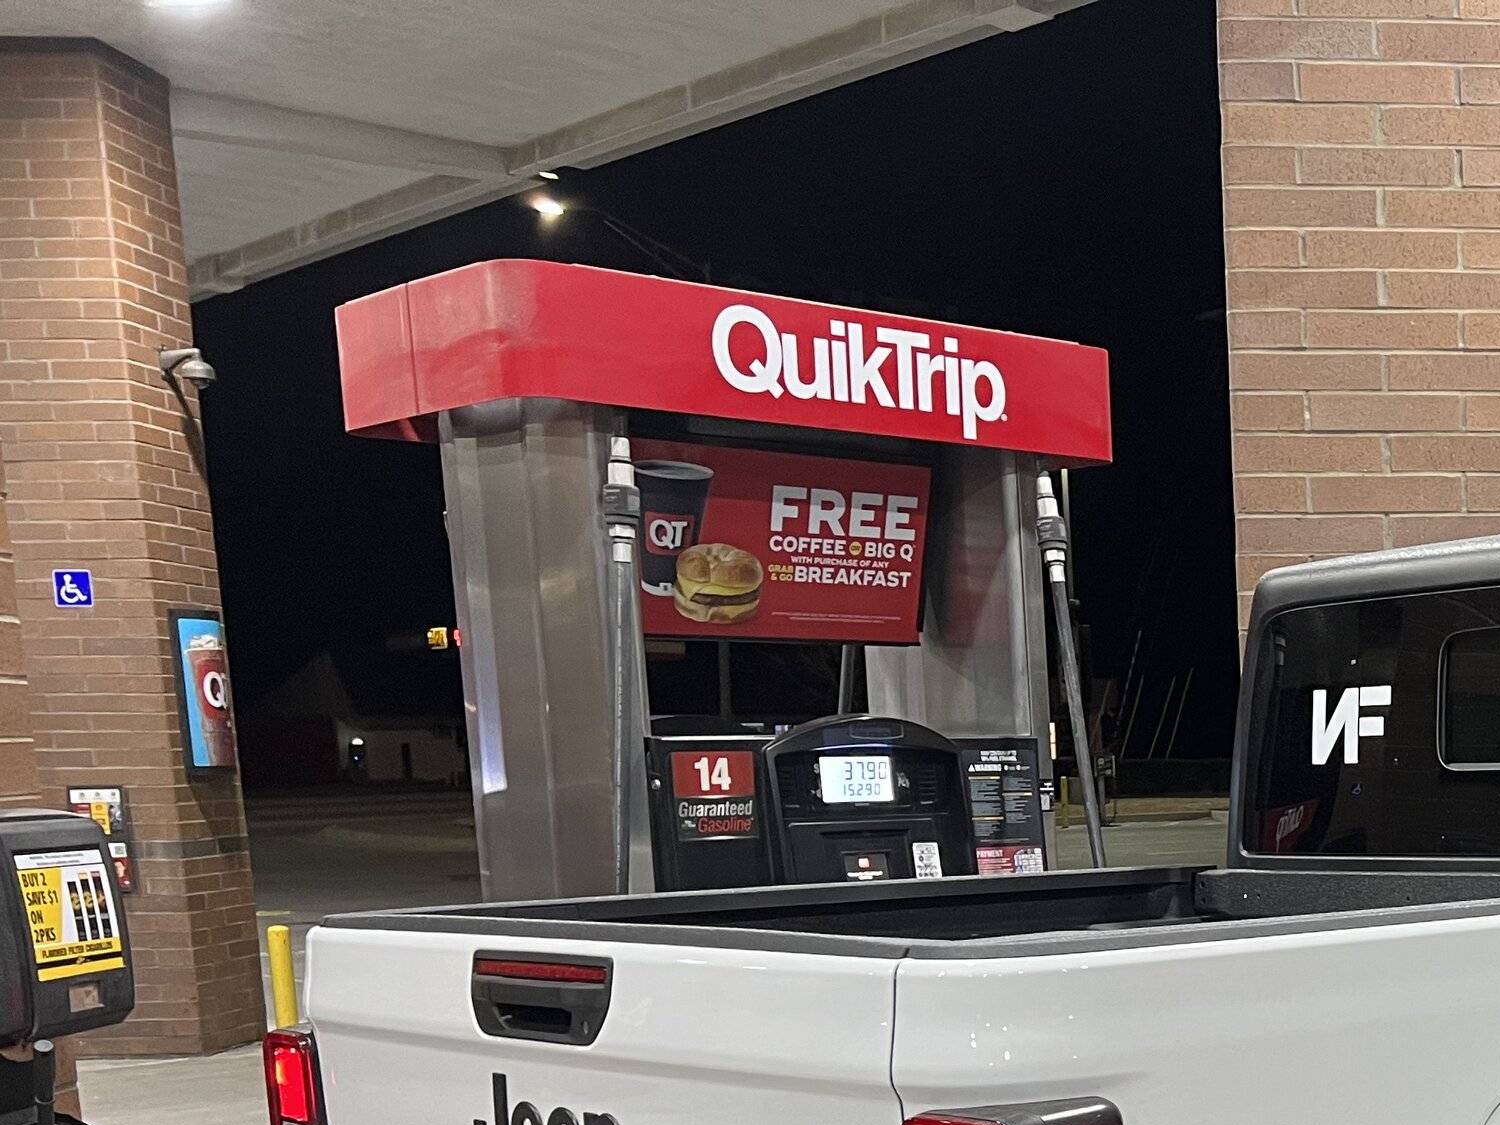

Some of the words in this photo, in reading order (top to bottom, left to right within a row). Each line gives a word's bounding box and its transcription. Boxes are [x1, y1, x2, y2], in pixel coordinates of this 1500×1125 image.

[712, 304, 1006, 440] QuikTrip
[770, 485, 918, 541] FREE
[649, 518, 688, 549] QT
[769, 535, 847, 556] COFFEE
[864, 541, 896, 559] BIG
[900, 543, 914, 562] Q
[768, 564, 794, 574] GRAB
[791, 555, 813, 565] WITH
[814, 556, 858, 567] PURCHASE
[859, 560, 871, 568] OF
[871, 560, 890, 569] ANY
[770, 572, 777, 581] &
[780, 573, 793, 582] GO
[794, 565, 912, 588] BREAKFAST
[203, 671, 227, 709] Q
[694, 757, 732, 791] 14
[679, 799, 753, 817] Guaranteed
[697, 817, 752, 833] Gasoline
[21, 872, 39, 888] BUY
[39, 872, 47, 886] 2
[26, 890, 47, 907] SAVE
[47, 889, 59, 905] $1
[30, 910, 44, 925] ON
[34, 927, 57, 944] 2PKS
